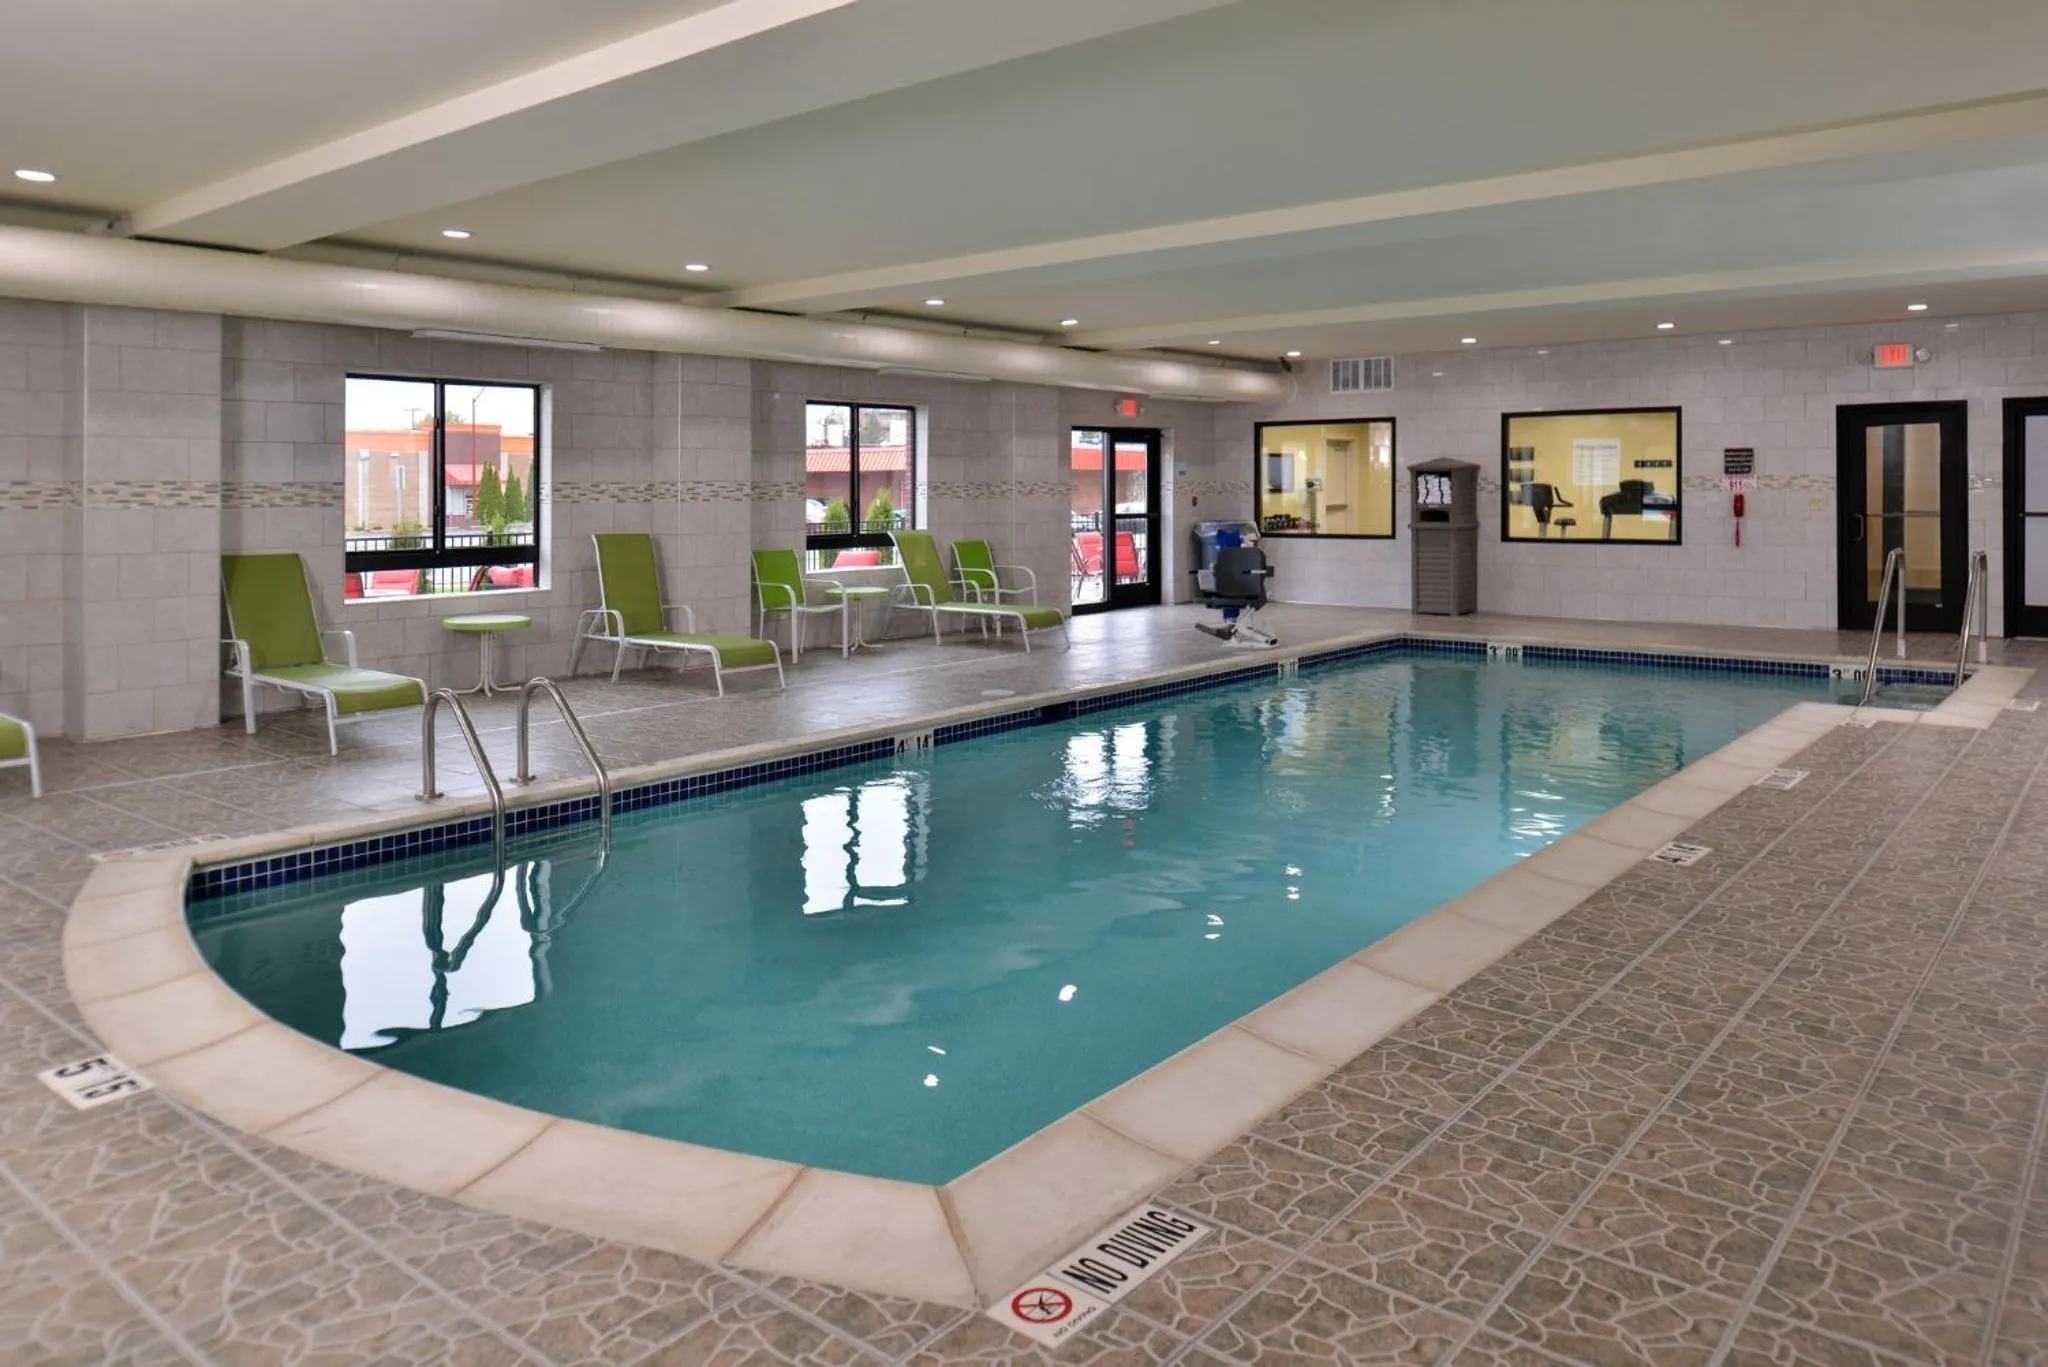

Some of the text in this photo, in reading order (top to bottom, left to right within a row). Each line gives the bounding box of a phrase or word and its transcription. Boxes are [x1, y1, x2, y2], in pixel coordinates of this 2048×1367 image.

[1879, 344, 1909, 368] EXIT
[1061, 1210, 1198, 1295] NO DIVING
